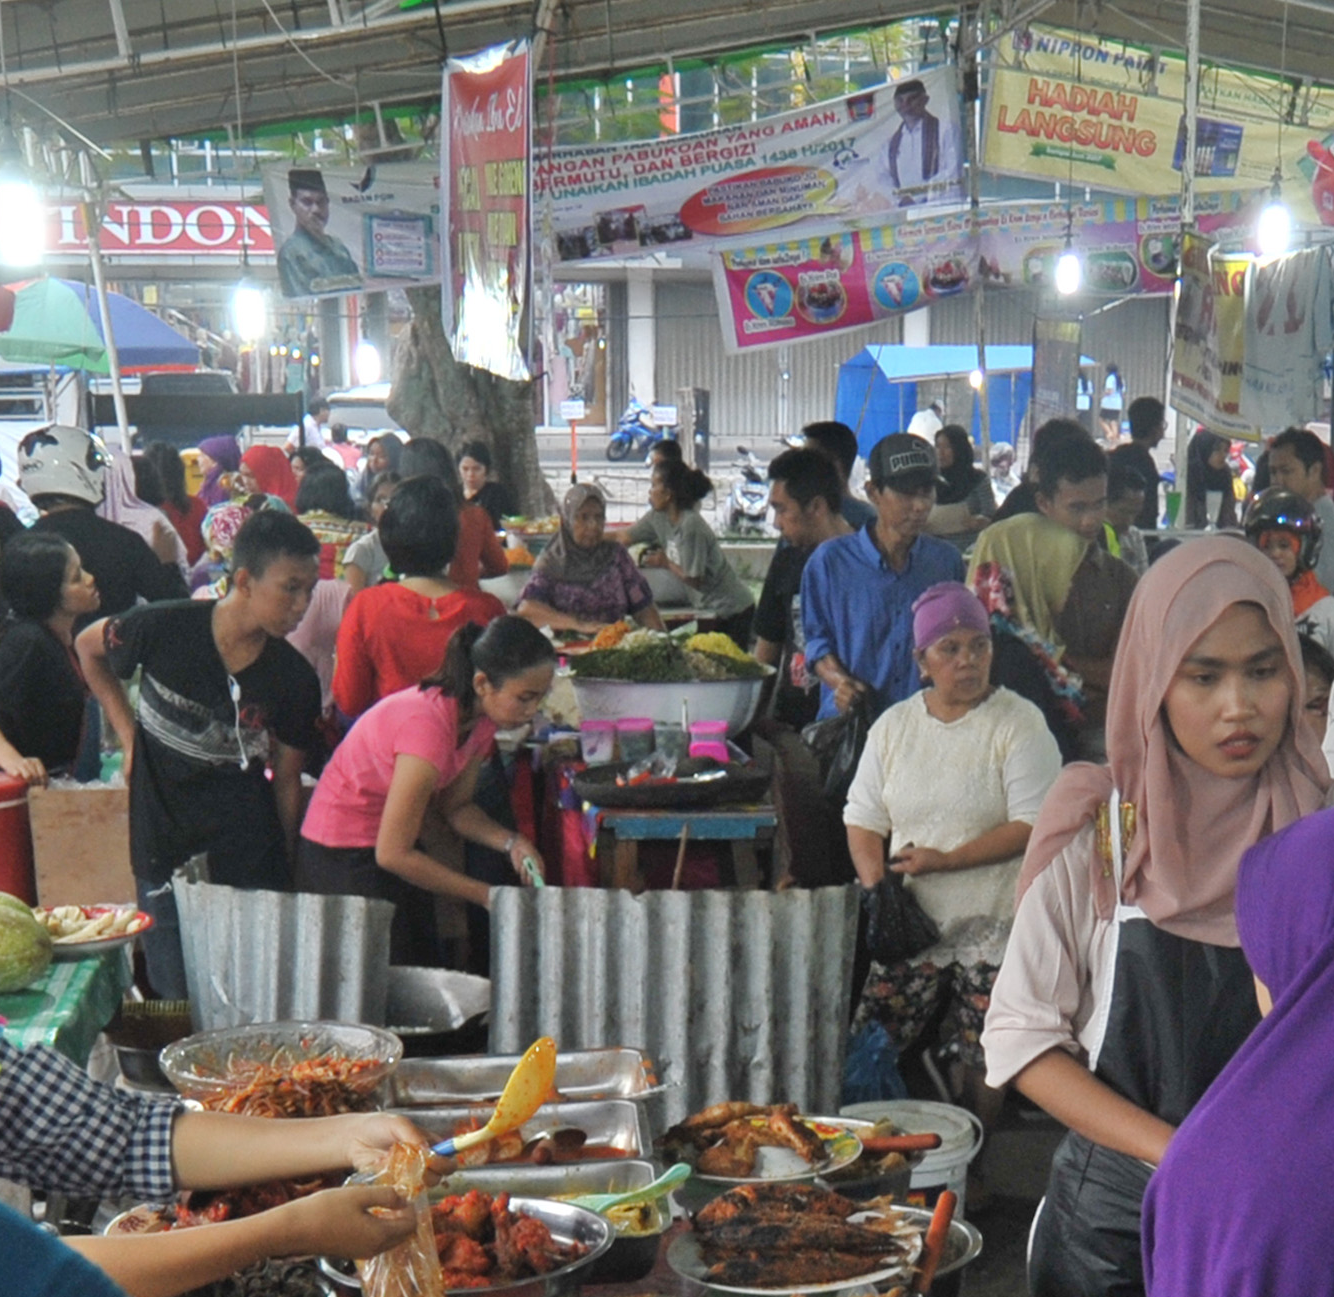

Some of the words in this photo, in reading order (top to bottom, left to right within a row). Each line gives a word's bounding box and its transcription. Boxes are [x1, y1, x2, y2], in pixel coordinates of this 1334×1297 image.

[1038, 36, 1110, 64] NIPPON
[1027, 77, 1139, 123] HADIAH
[612, 136, 719, 165] PABUKOAN
[726, 125, 775, 144] YANG
[996, 104, 1158, 158] LANGSUNG
[633, 157, 674, 176] DAN
[680, 142, 756, 168] BERGIZI
[633, 168, 697, 189] IBADAH
[700, 156, 756, 176] PUASA
[889, 450, 933, 473] PUMA
